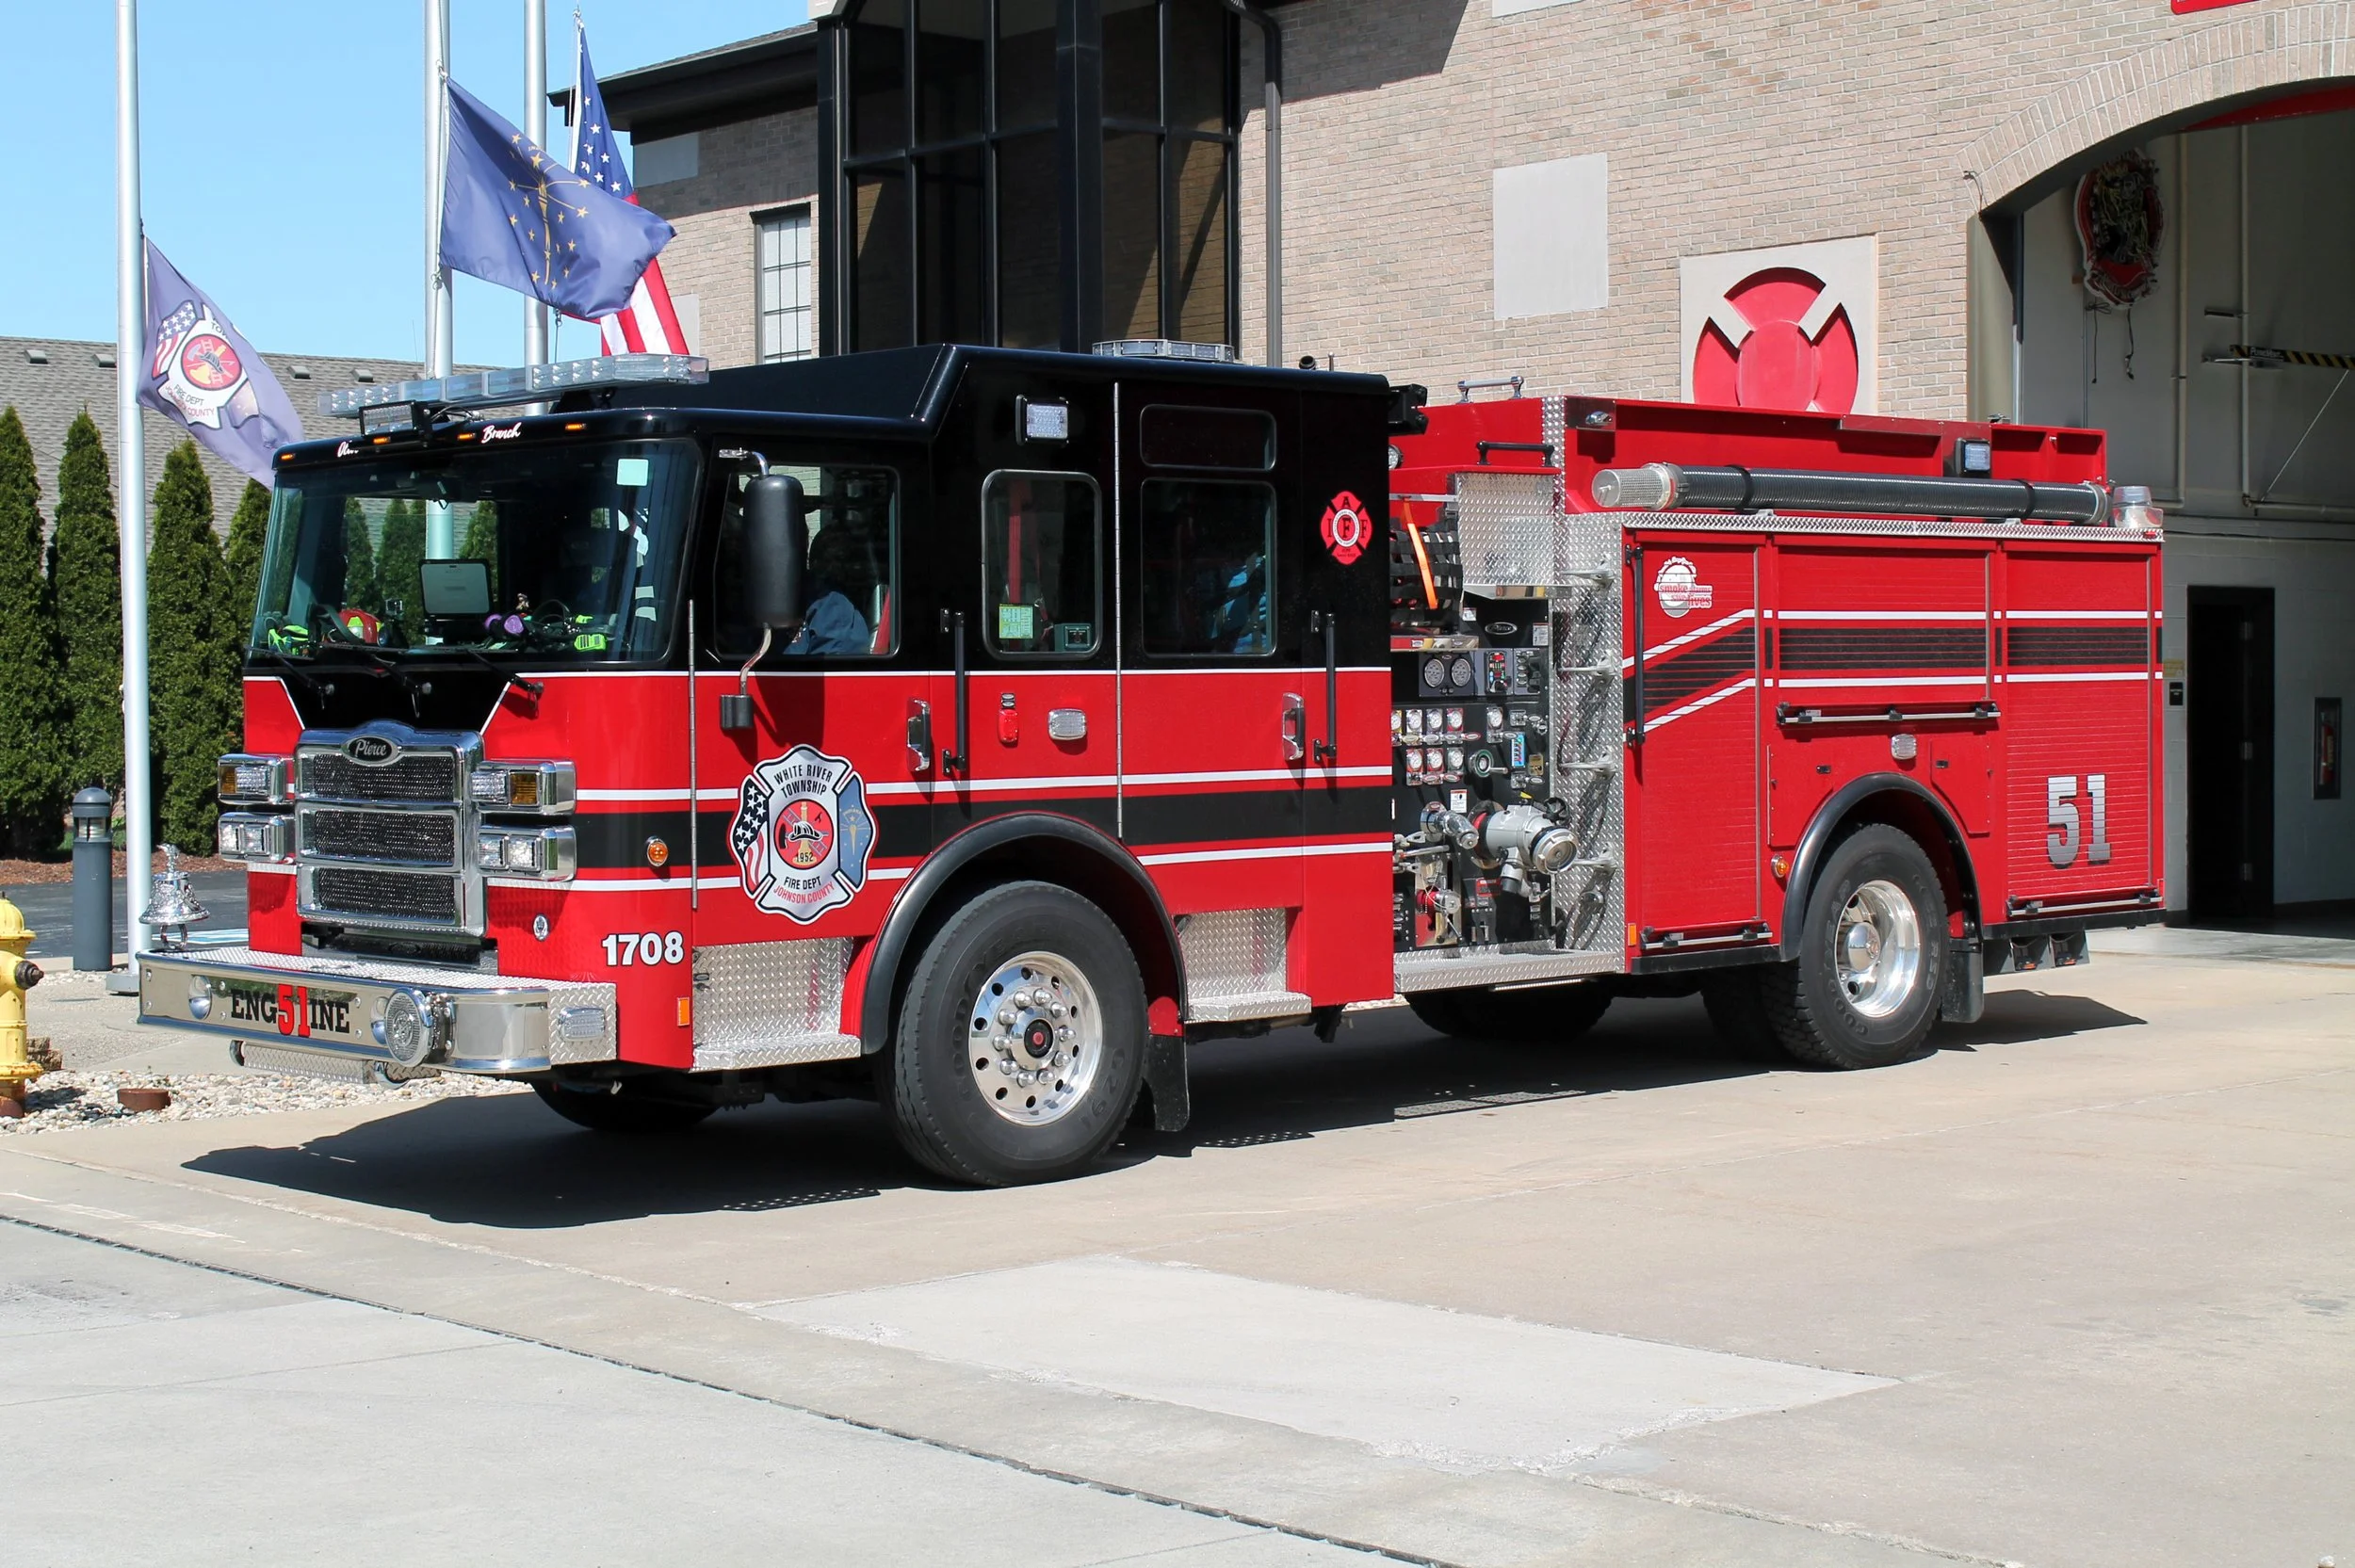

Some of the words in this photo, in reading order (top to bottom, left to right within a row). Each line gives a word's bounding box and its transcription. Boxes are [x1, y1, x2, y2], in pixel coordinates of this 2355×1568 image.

[186, 395, 204, 406] DEPT
[187, 408, 215, 417] COUNTY
[480, 422, 522, 444] Branch
[1660, 584, 1688, 592] smoke
[355, 738, 387, 757] Pierce
[773, 764, 803, 784] WHITE
[806, 764, 833, 783] RIVER
[781, 779, 827, 799] TOWNSHIP
[2047, 774, 2111, 868] 51
[796, 851, 814, 863] 1952
[773, 885, 806, 904] JOHNSON
[807, 881, 835, 903] COUNTY
[784, 876, 801, 890] FIRE
[803, 876, 821, 890] DEPT
[601, 930, 685, 966] 1708
